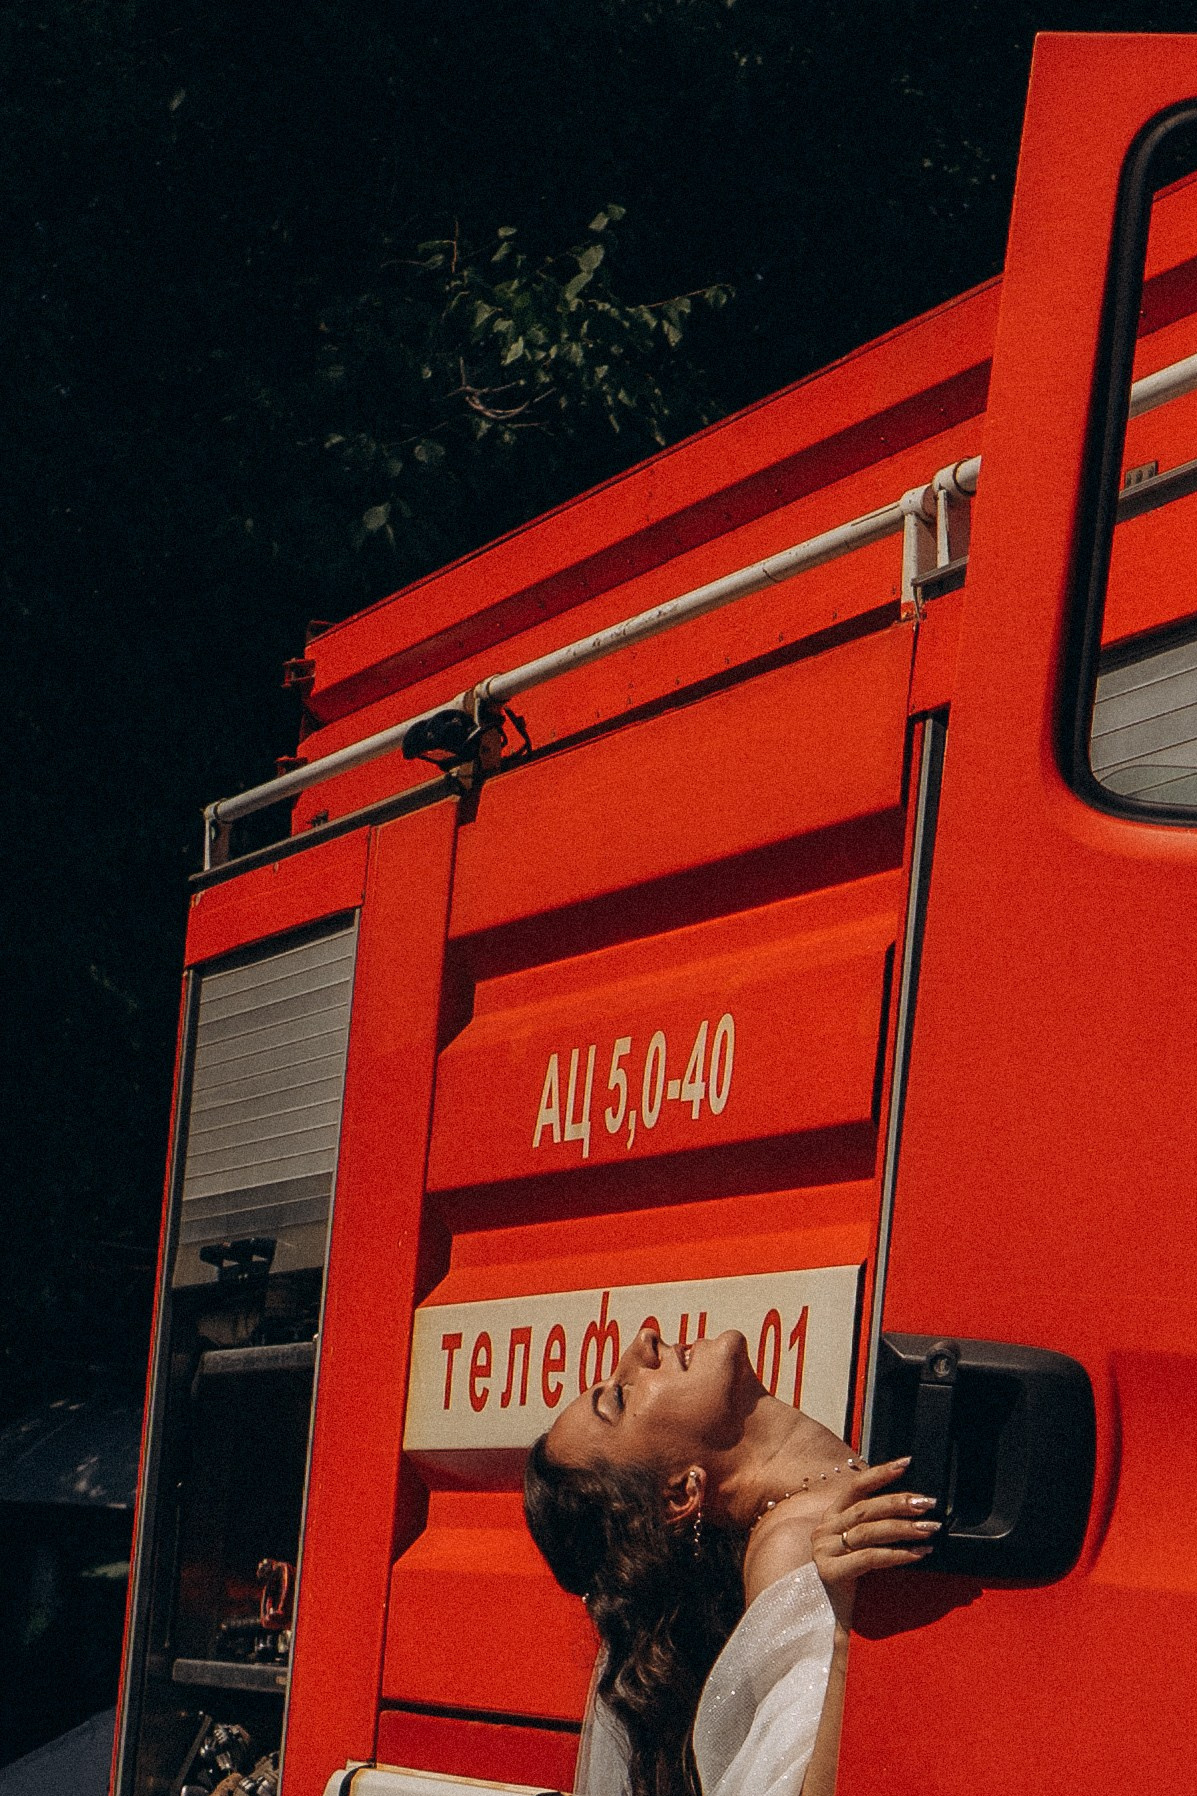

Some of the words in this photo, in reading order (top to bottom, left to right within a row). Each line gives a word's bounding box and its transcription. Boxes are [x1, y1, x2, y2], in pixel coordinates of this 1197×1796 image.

[532, 1044, 597, 1159] АЦ
[604, 1012, 736, 1151] 5,0-40
[441, 1291, 708, 1412] телеф
[757, 1305, 810, 1408] 01
